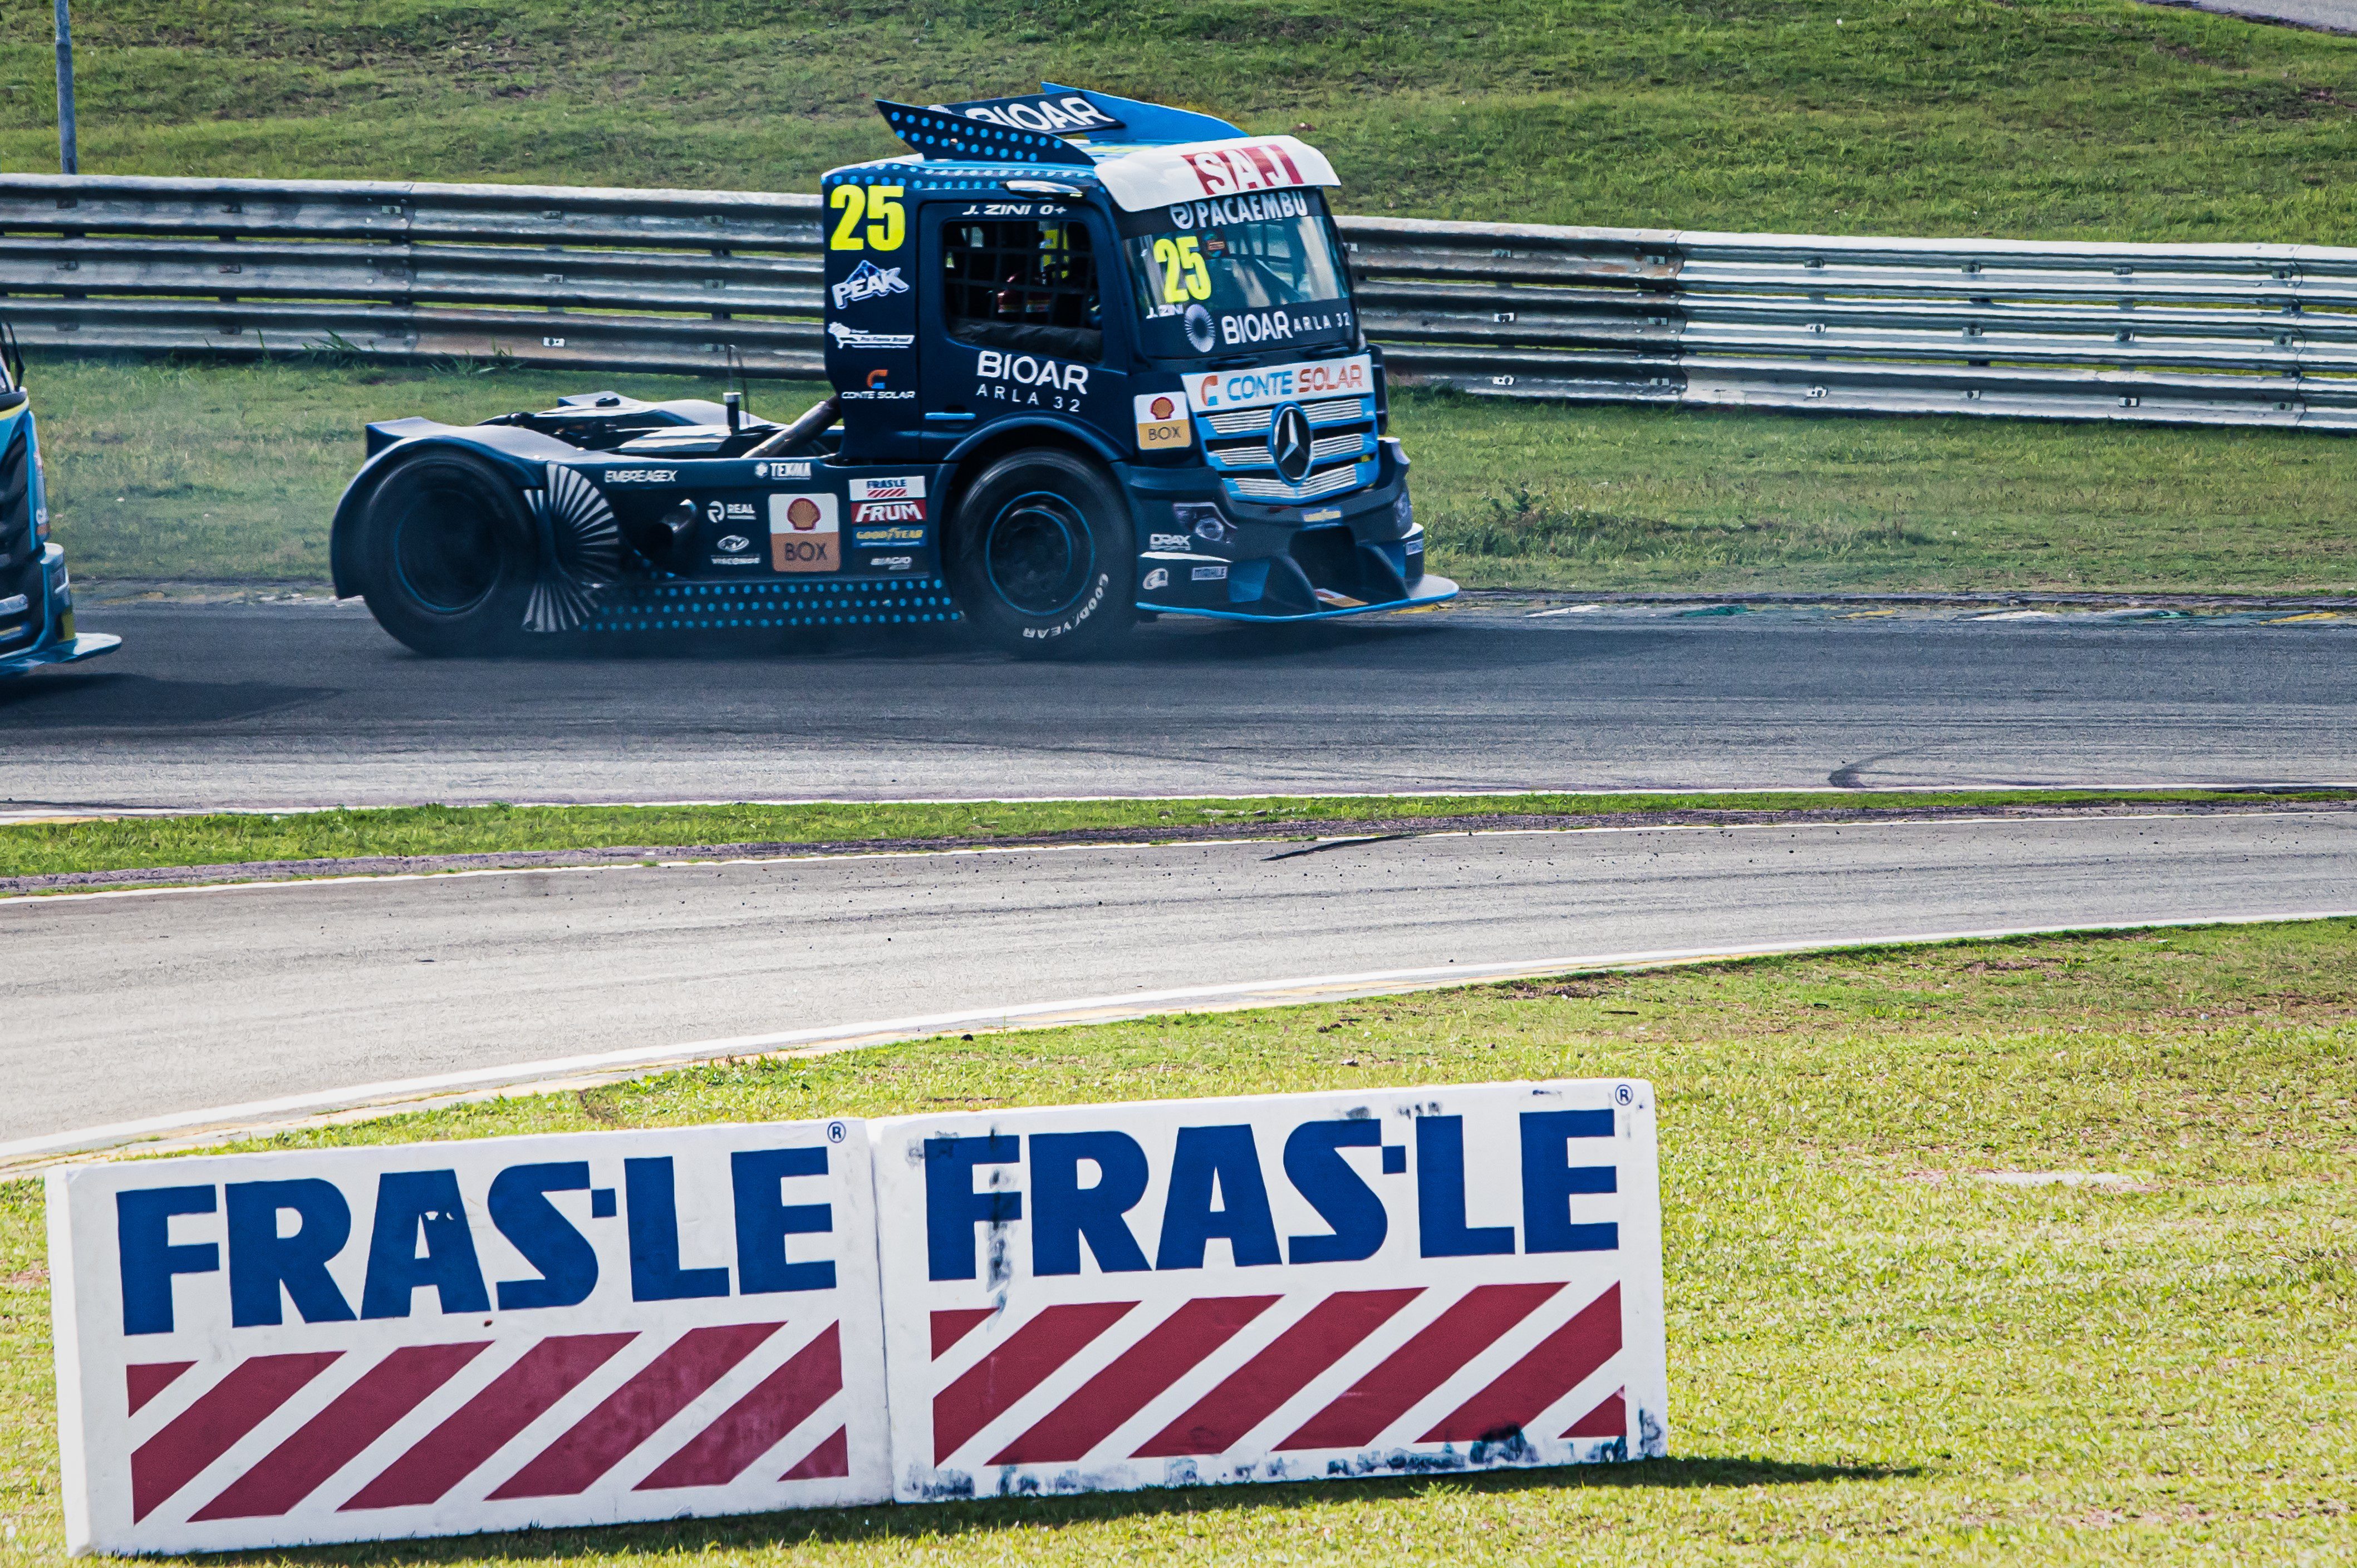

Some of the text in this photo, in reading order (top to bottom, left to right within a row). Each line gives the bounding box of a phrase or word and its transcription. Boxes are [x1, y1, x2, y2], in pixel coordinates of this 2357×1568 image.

[1190, 145, 1297, 195] SAJ
[830, 184, 906, 251] 25
[983, 204, 1032, 215] ZINI
[1195, 191, 1308, 228] PACAEMBU
[1153, 235, 1211, 303] 25
[832, 267, 910, 309] PEAK
[1221, 310, 1294, 345] BIOAR
[1293, 314, 1332, 332] ARLA
[976, 350, 1089, 395] BIOAR
[1227, 364, 1363, 401] CONTE SOLAR
[841, 391, 916, 399] CONTE SOLAR
[976, 384, 1081, 412] ARLA 32
[1148, 426, 1181, 441] BOX
[727, 504, 755, 514] REAL
[855, 501, 923, 523] FRUM
[784, 541, 827, 561] BOX
[1150, 533, 1191, 546] DRAX
